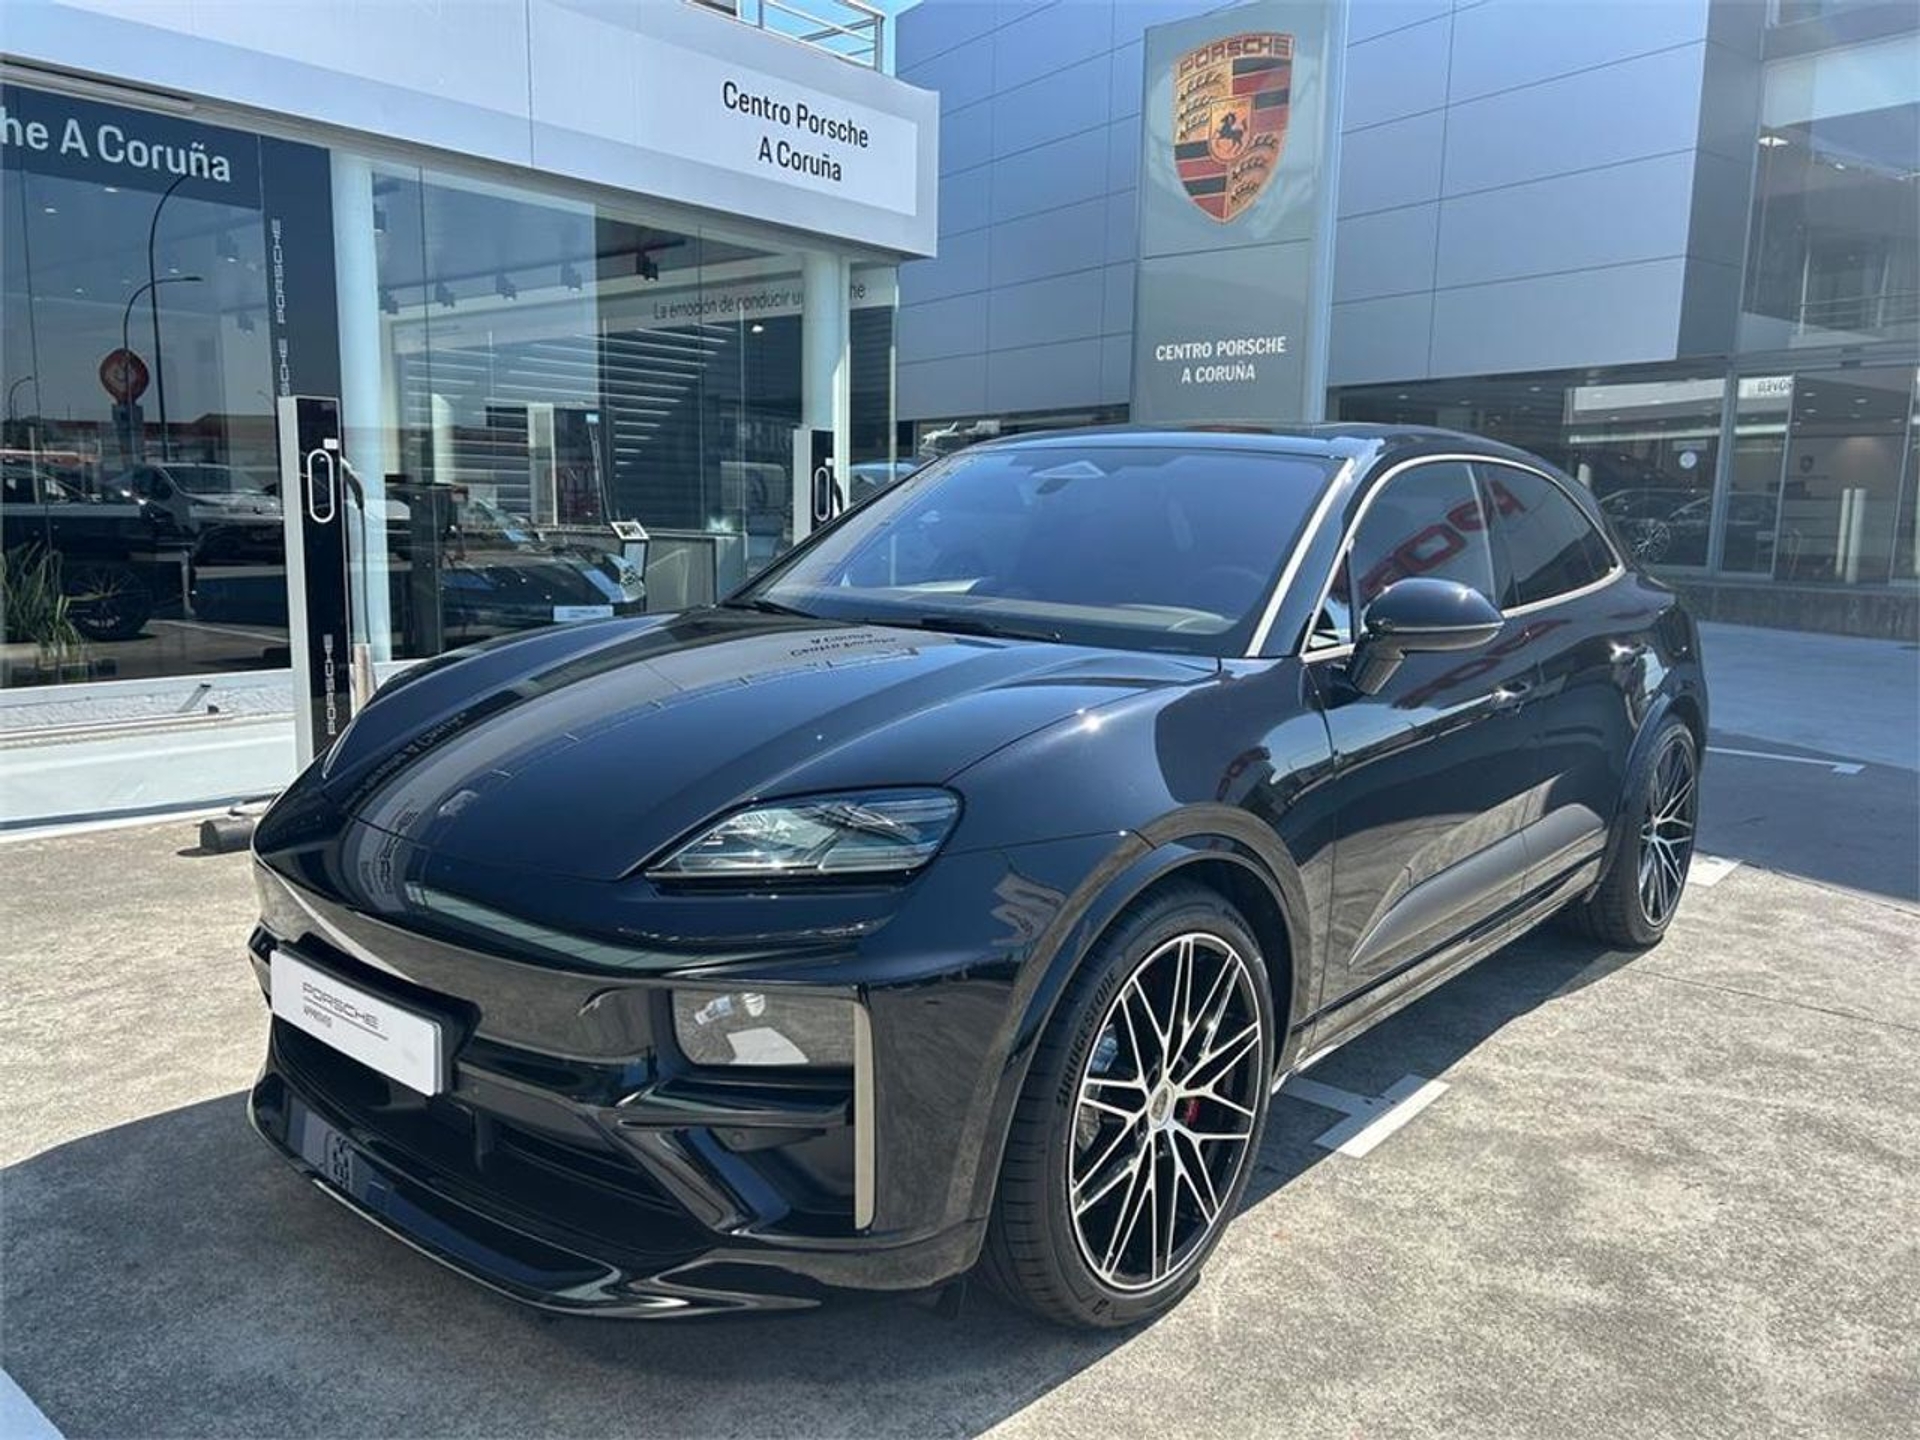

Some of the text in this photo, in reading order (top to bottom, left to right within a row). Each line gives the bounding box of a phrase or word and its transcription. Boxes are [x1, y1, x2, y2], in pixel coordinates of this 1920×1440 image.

[1179, 36, 1293, 75] PORSCHE
[723, 81, 868, 148] Centro Porsche
[60, 118, 89, 157] A
[97, 124, 231, 183] Coruña
[758, 136, 842, 182] A Coruña
[271, 219, 286, 324] PORSCHE
[1156, 336, 1287, 360] CENTRO PORSCHE
[1181, 360, 1256, 384] A CORUÑA
[323, 634, 337, 735] PORSCHE
[302, 982, 380, 1030] PORSCHE
